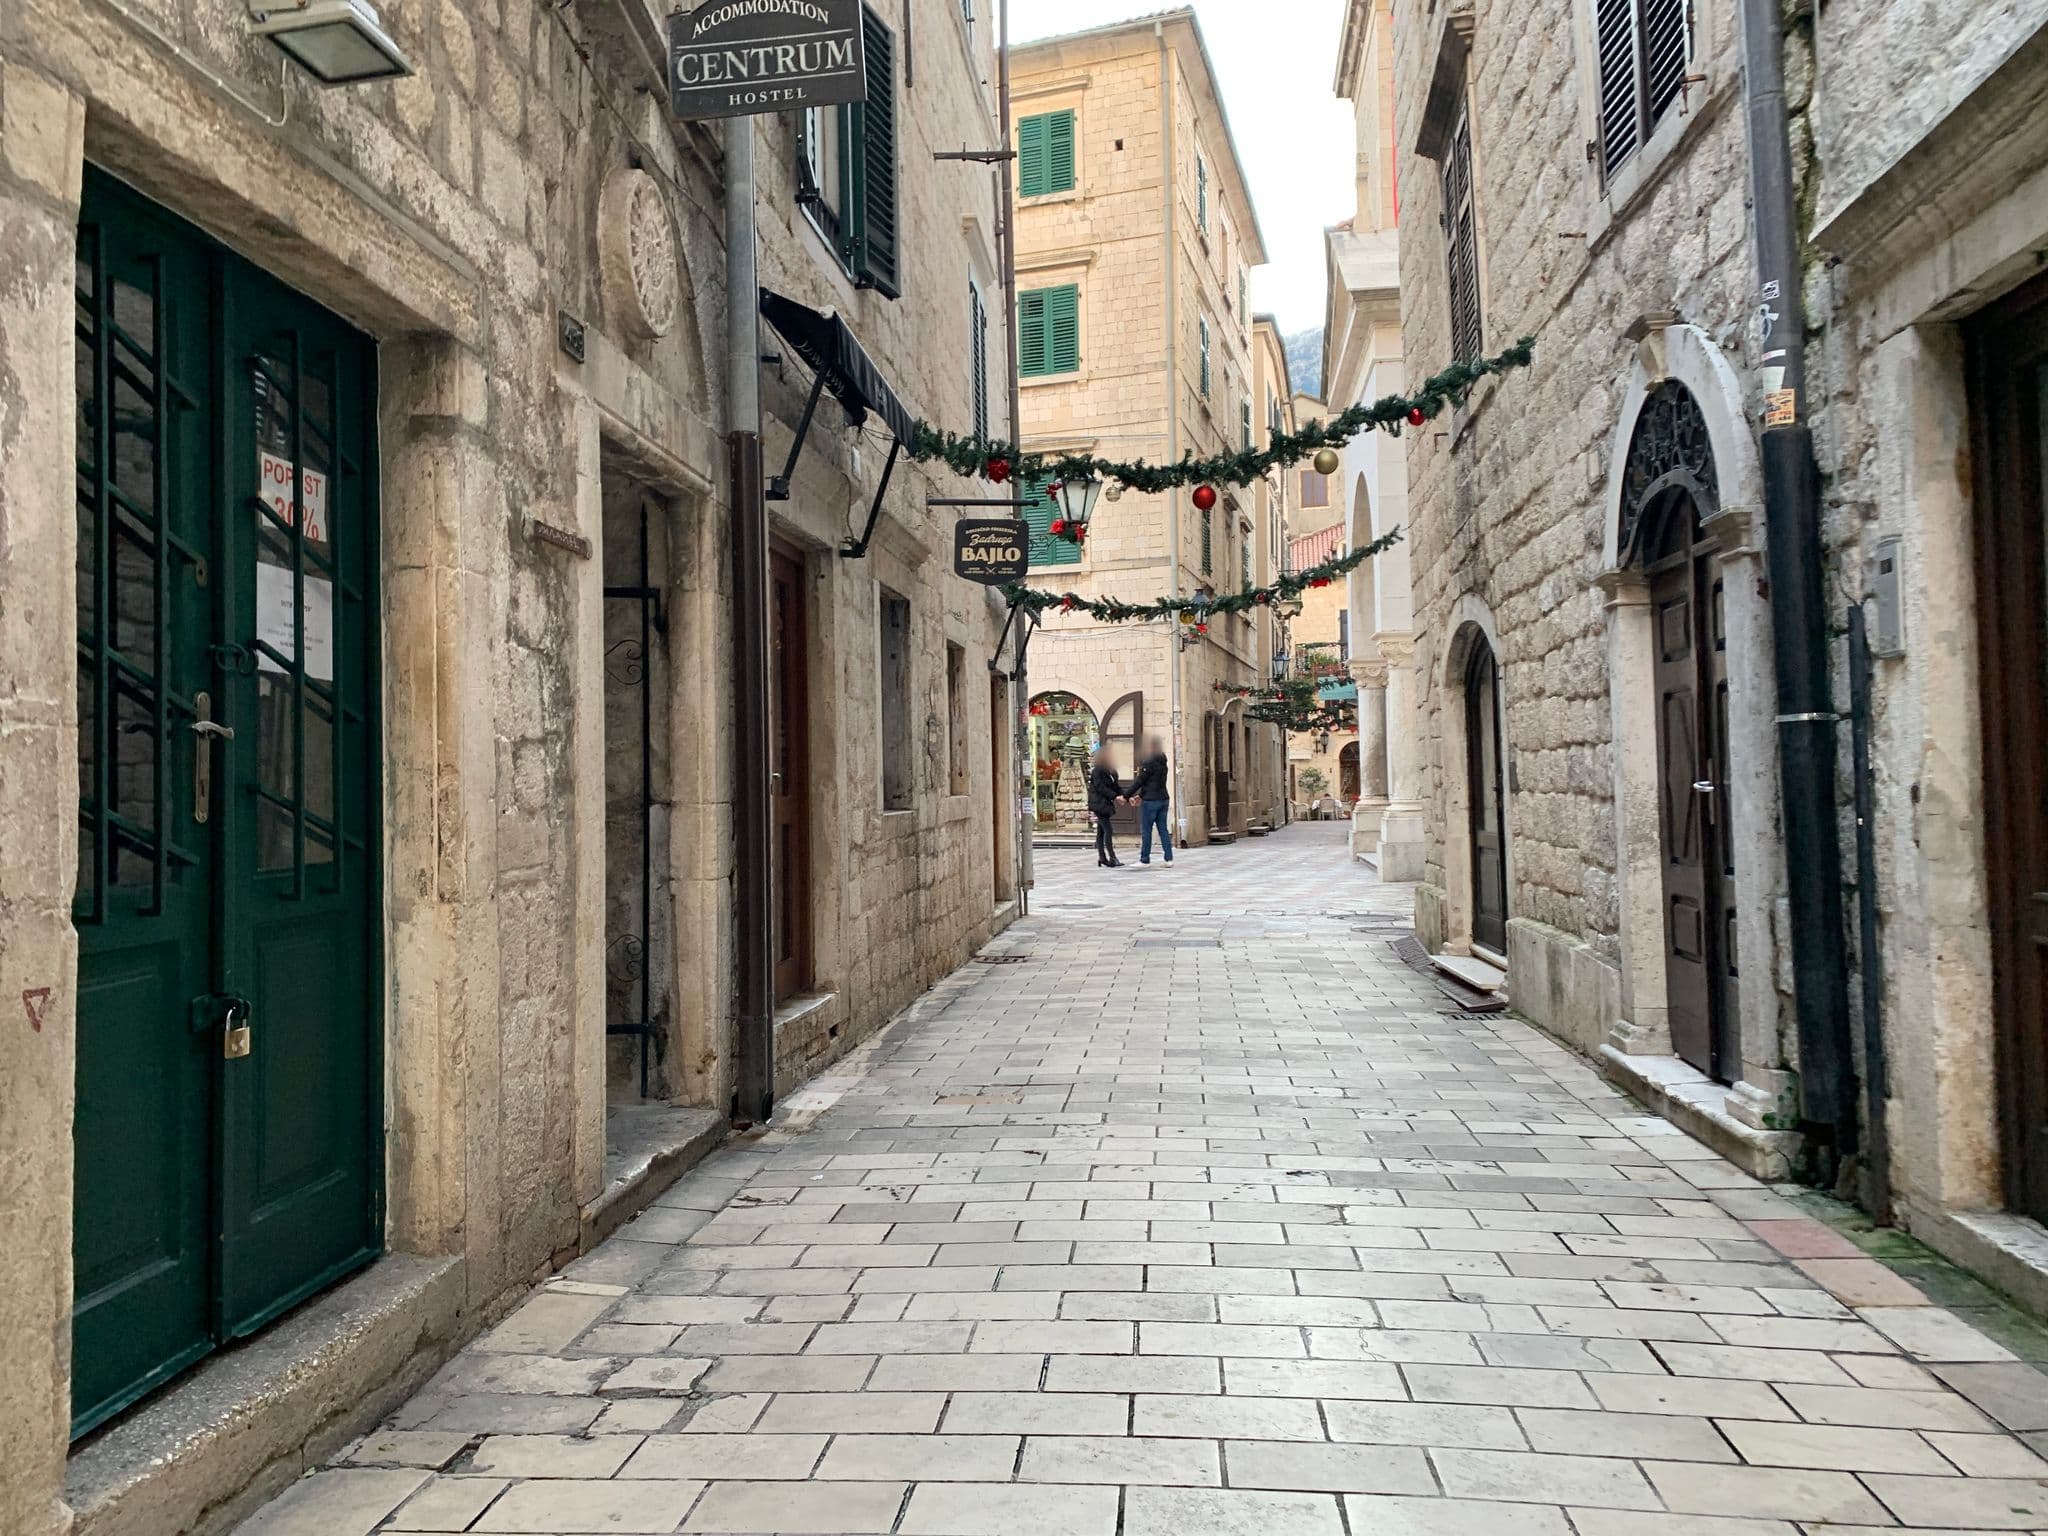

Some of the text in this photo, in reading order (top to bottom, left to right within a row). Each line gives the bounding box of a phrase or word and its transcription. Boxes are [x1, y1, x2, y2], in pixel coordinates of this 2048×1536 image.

[692, 0, 829, 38] ACCOMMODATION
[676, 38, 855, 83] CENTRUM
[729, 87, 808, 105] HOSTEL
[264, 459, 321, 497] POPST
[961, 547, 1021, 564] BAJLO
